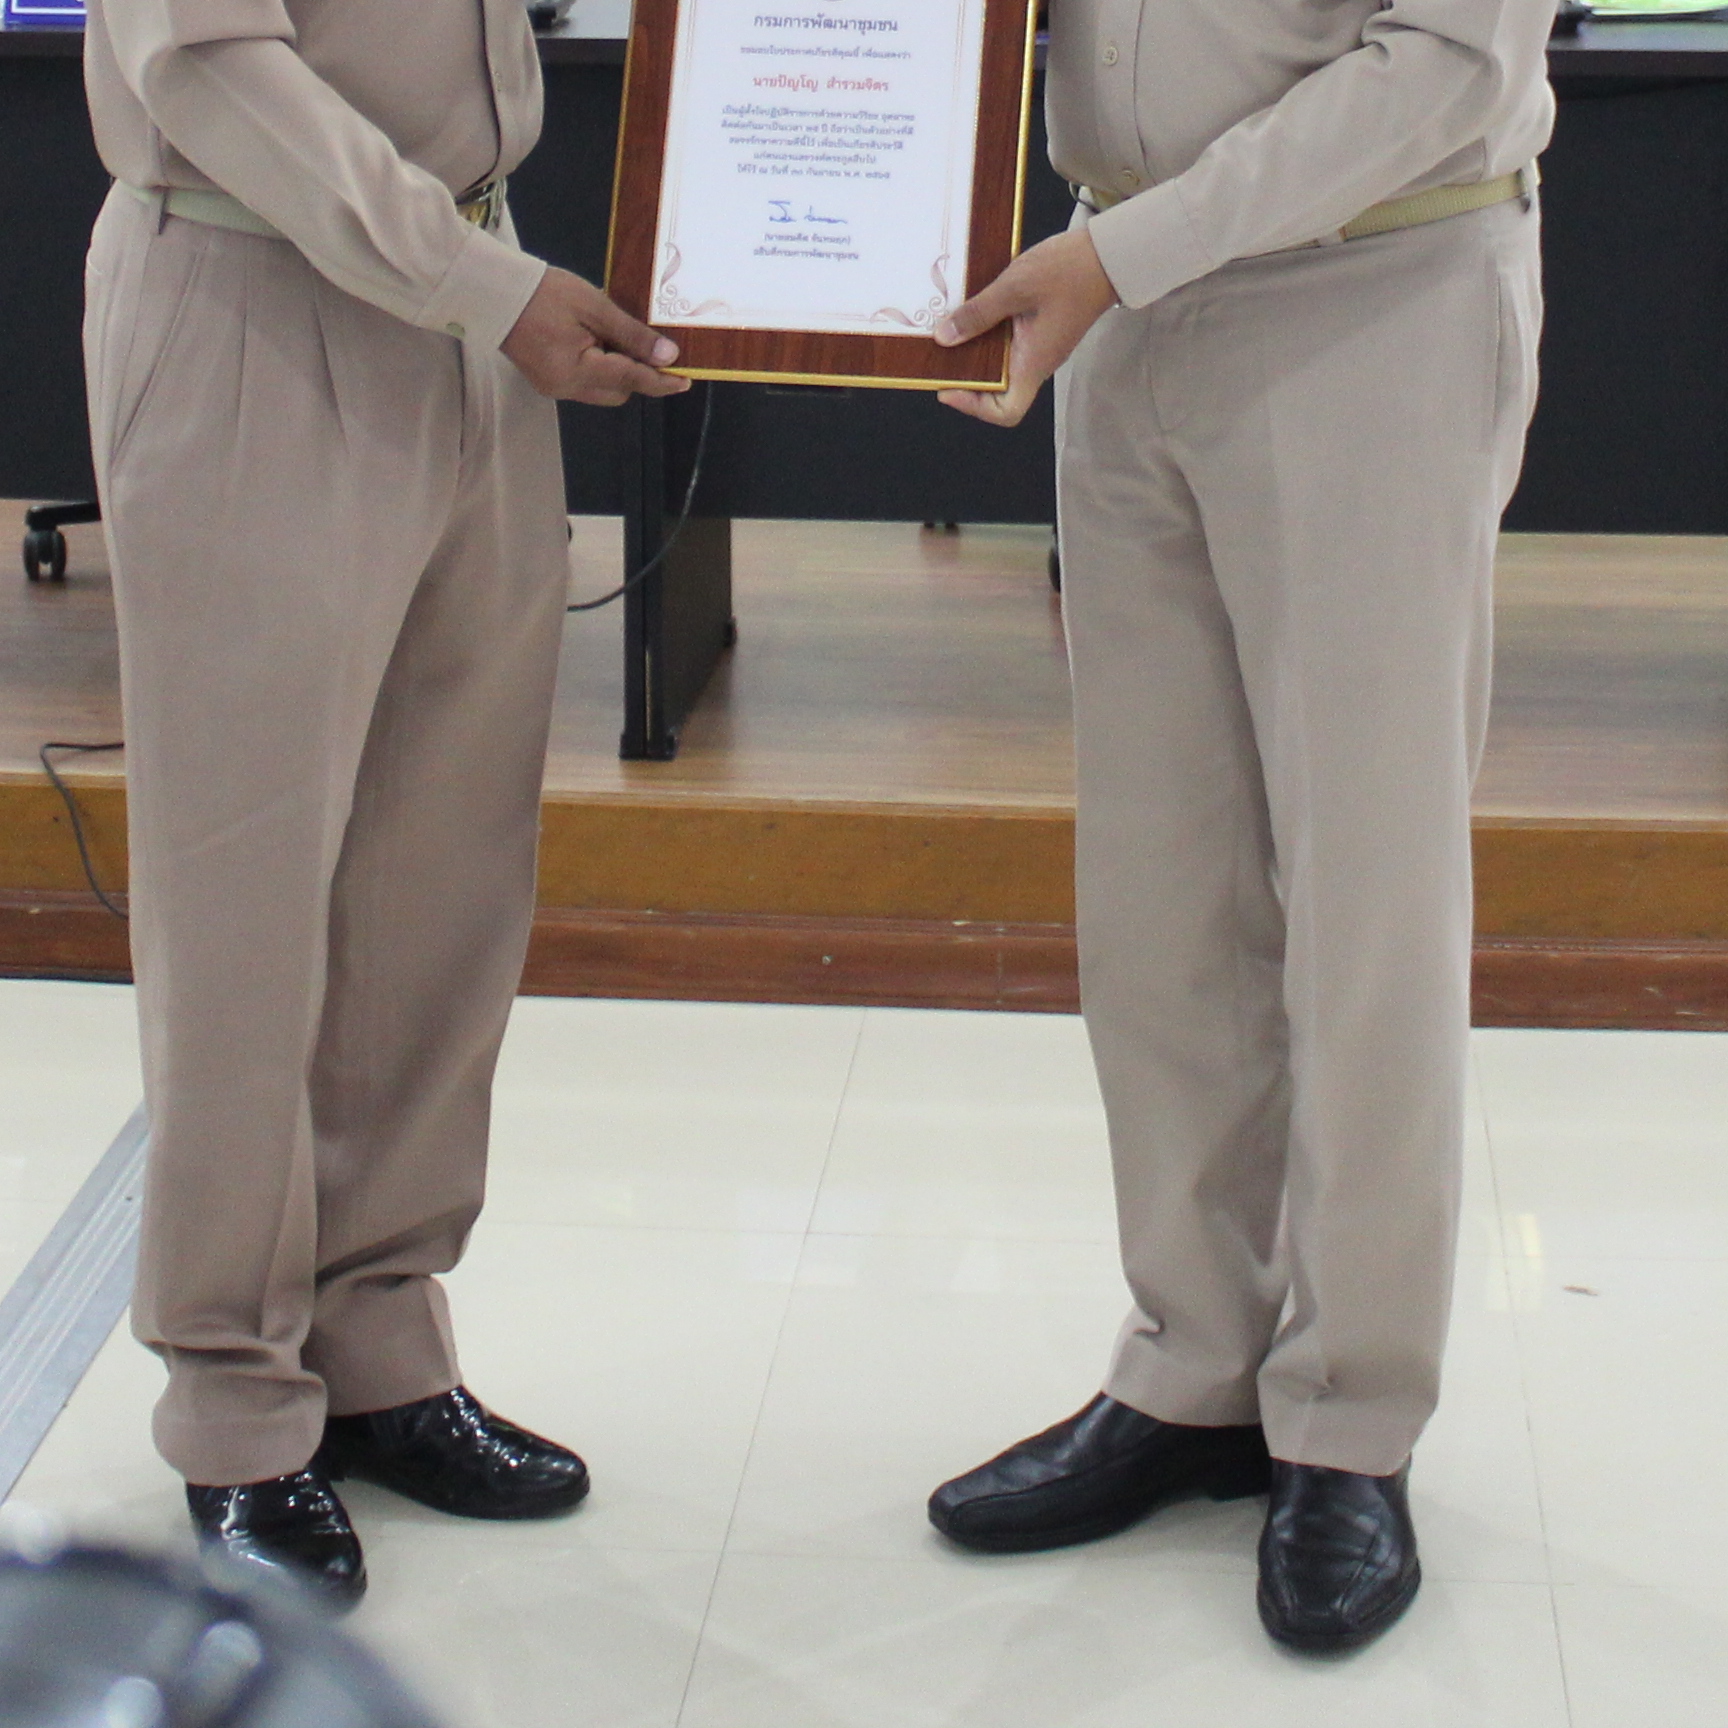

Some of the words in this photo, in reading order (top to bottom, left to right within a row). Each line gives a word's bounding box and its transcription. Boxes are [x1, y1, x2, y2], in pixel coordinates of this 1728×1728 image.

[753, 12, 898, 36] กรมการพัฒนาชุมชน
